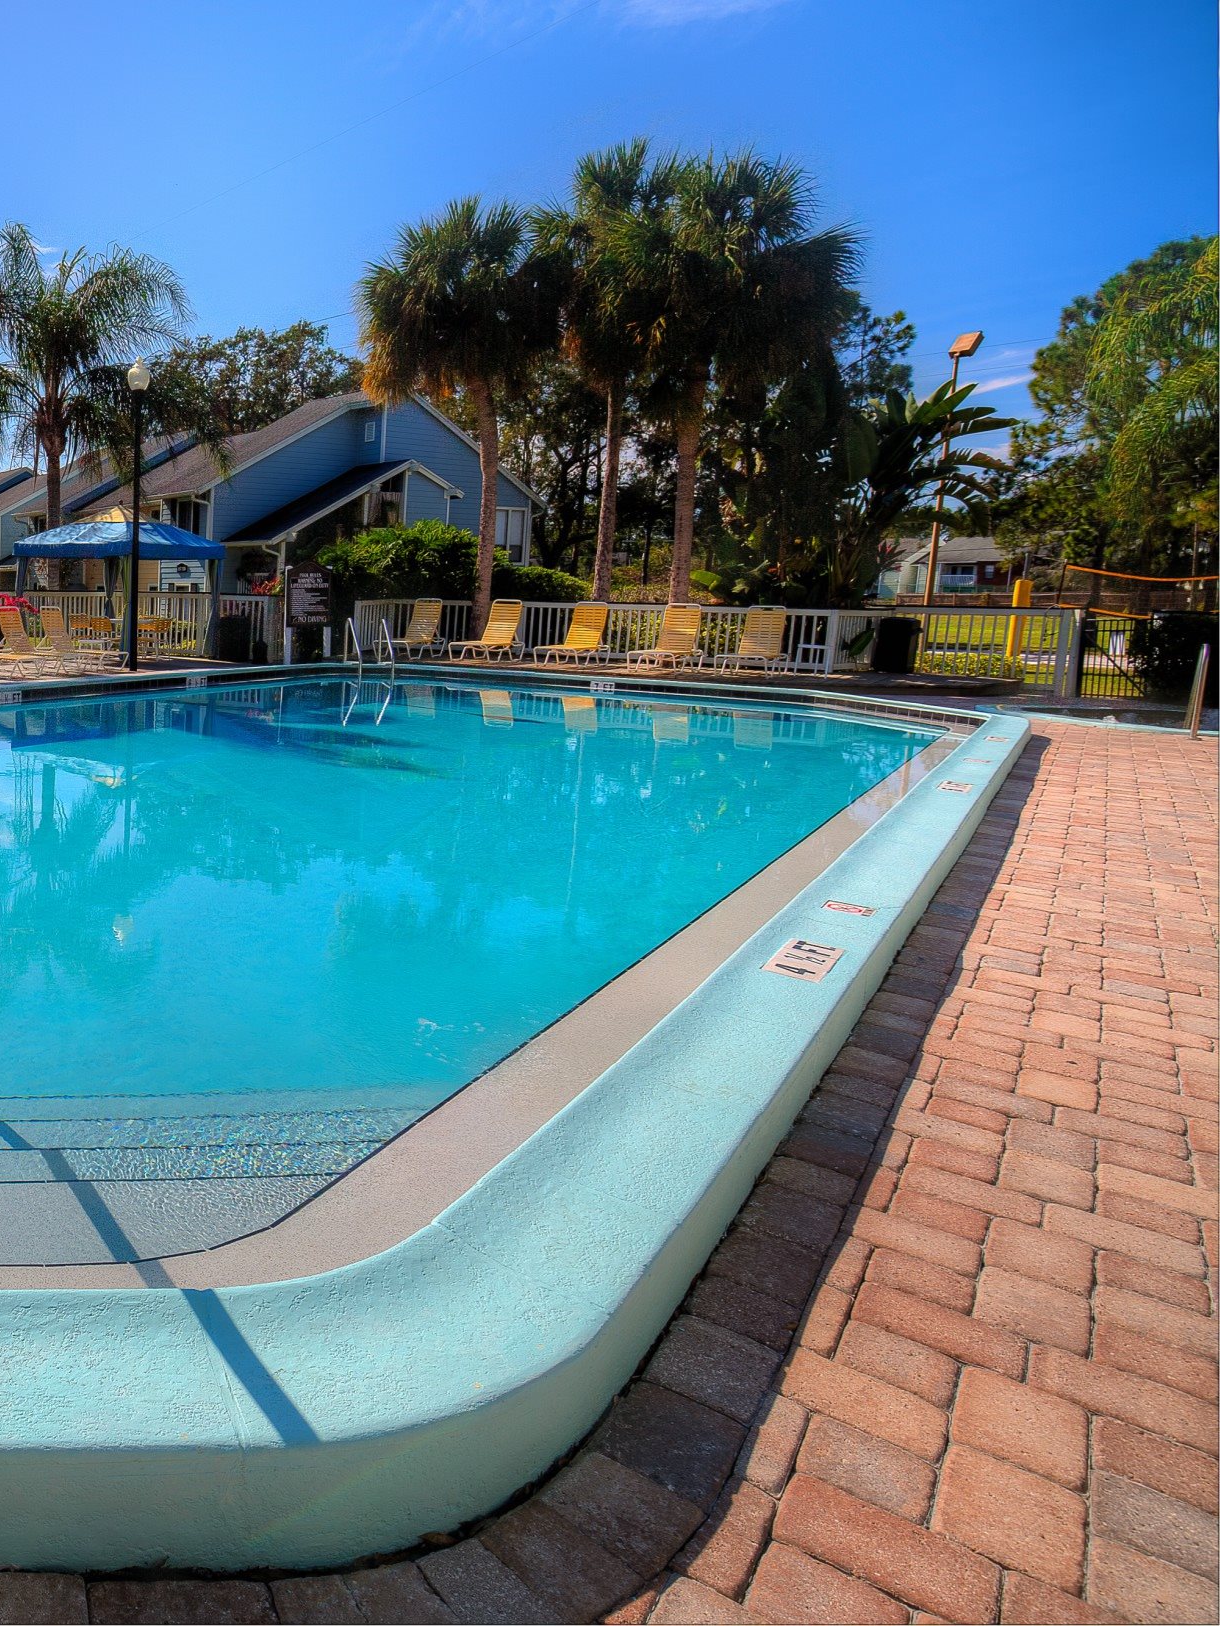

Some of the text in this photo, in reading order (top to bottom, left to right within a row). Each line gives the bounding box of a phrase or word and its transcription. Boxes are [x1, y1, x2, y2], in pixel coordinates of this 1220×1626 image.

[297, 615, 327, 623] NO DIVING
[12, 692, 21, 703] FT
[792, 940, 837, 957] FT
[775, 963, 816, 976] 4
